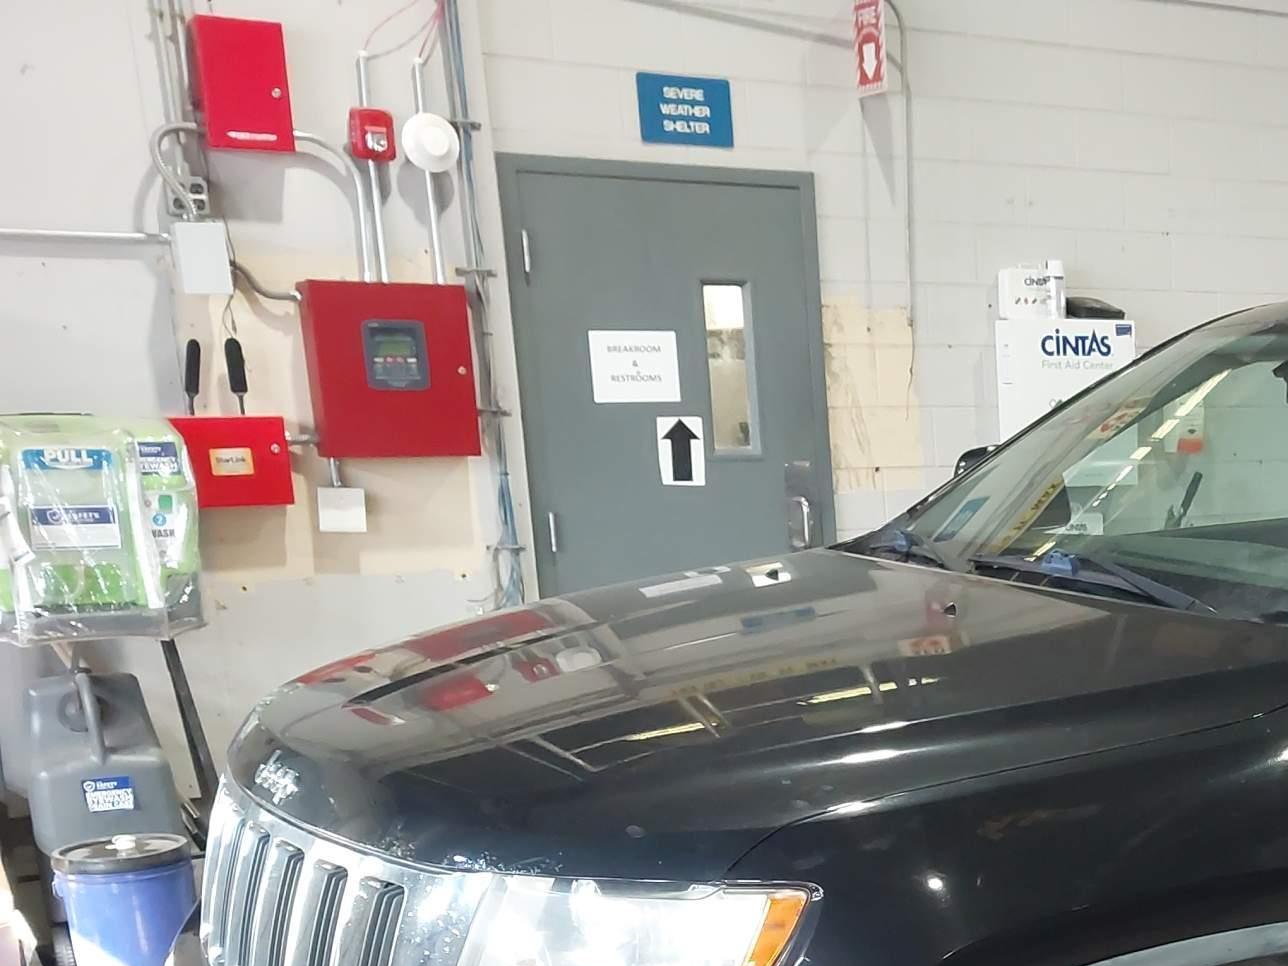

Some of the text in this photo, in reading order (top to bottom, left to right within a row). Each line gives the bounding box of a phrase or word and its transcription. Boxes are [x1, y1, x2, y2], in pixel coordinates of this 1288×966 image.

[662, 86, 704, 101] SEVERE
[659, 103, 711, 118] WEATHER
[663, 119, 710, 135] SHELTER
[606, 344, 662, 353] BREAKROOM
[631, 359, 639, 367] &
[1041, 360, 1113, 370] First Aid Center
[610, 374, 662, 383] RESTROOMS
[43, 447, 94, 465] PULL
